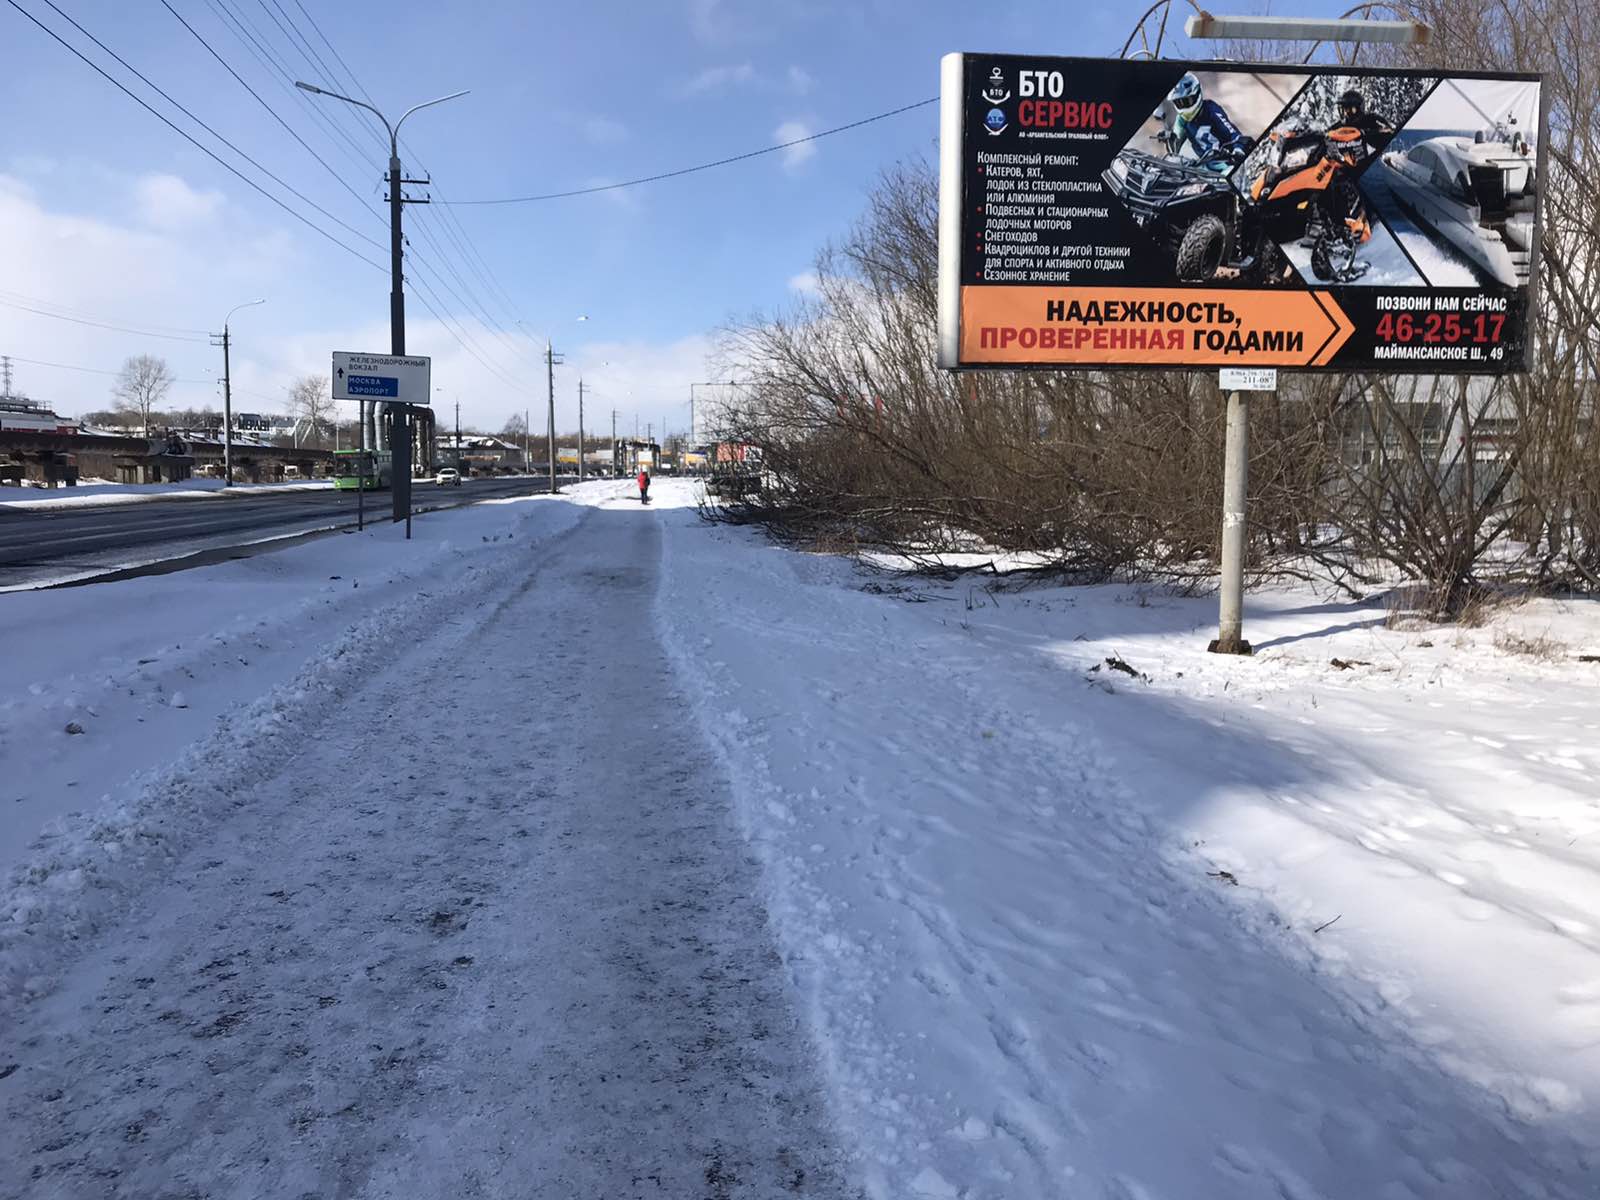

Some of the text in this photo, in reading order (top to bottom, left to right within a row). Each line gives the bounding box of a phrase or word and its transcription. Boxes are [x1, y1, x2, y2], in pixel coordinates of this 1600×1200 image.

[1019, 71, 1064, 98] БТО
[1018, 100, 1113, 128] СЕРВИС
[977, 151, 1078, 166] КОМПЛЕКСНЫЙ РЕМОНТ:
[986, 166, 1044, 179] КАТЕРОВ, ЯХТ,
[986, 180, 1102, 193] ЛОДОК ИЗ СТЕКЛОПЛАСТИКА
[987, 193, 1054, 204] ИЛИ АЛЮМИНИЯ
[985, 204, 1108, 218] ПОДВЕСНЫХ И СТАЦИОНАРНЫХ
[986, 218, 1072, 230] ЛОДОЧНЫХ МОТОРОВ
[985, 230, 1038, 242] СНЕГОХОДОВ
[984, 244, 1130, 258] КВАДРОЦИКЛОВ И ДРУГОЙ ТЕХНИКИ
[985, 258, 1124, 271] ДЛЯ СПОРТА И АКТИВНОГО ОТДЫХА
[984, 269, 1070, 282] СЕЗОННОЕ ХРАНЕНИЕ
[1376, 294, 1507, 312] ПОЗВОНИ НАМ СЕЙЧАС
[1046, 301, 1242, 327] НАДЕЖНОСТЬ,
[1376, 313, 1506, 344] 46-25-17
[980, 327, 1304, 355] ПРОВЕРЕННАЯ ГОДАМИ
[1374, 345, 1467, 361] МАЙМАКСАНСКОЕ
[1490, 347, 1504, 361] 49
[348, 364, 378, 372] ВОКЗАЛ
[349, 356, 426, 367] ЖЕЛЕЗНОДОРОЖНЫЙ
[349, 377, 381, 385] МОСКВА
[349, 387, 389, 395] АЭРОПОРТ
